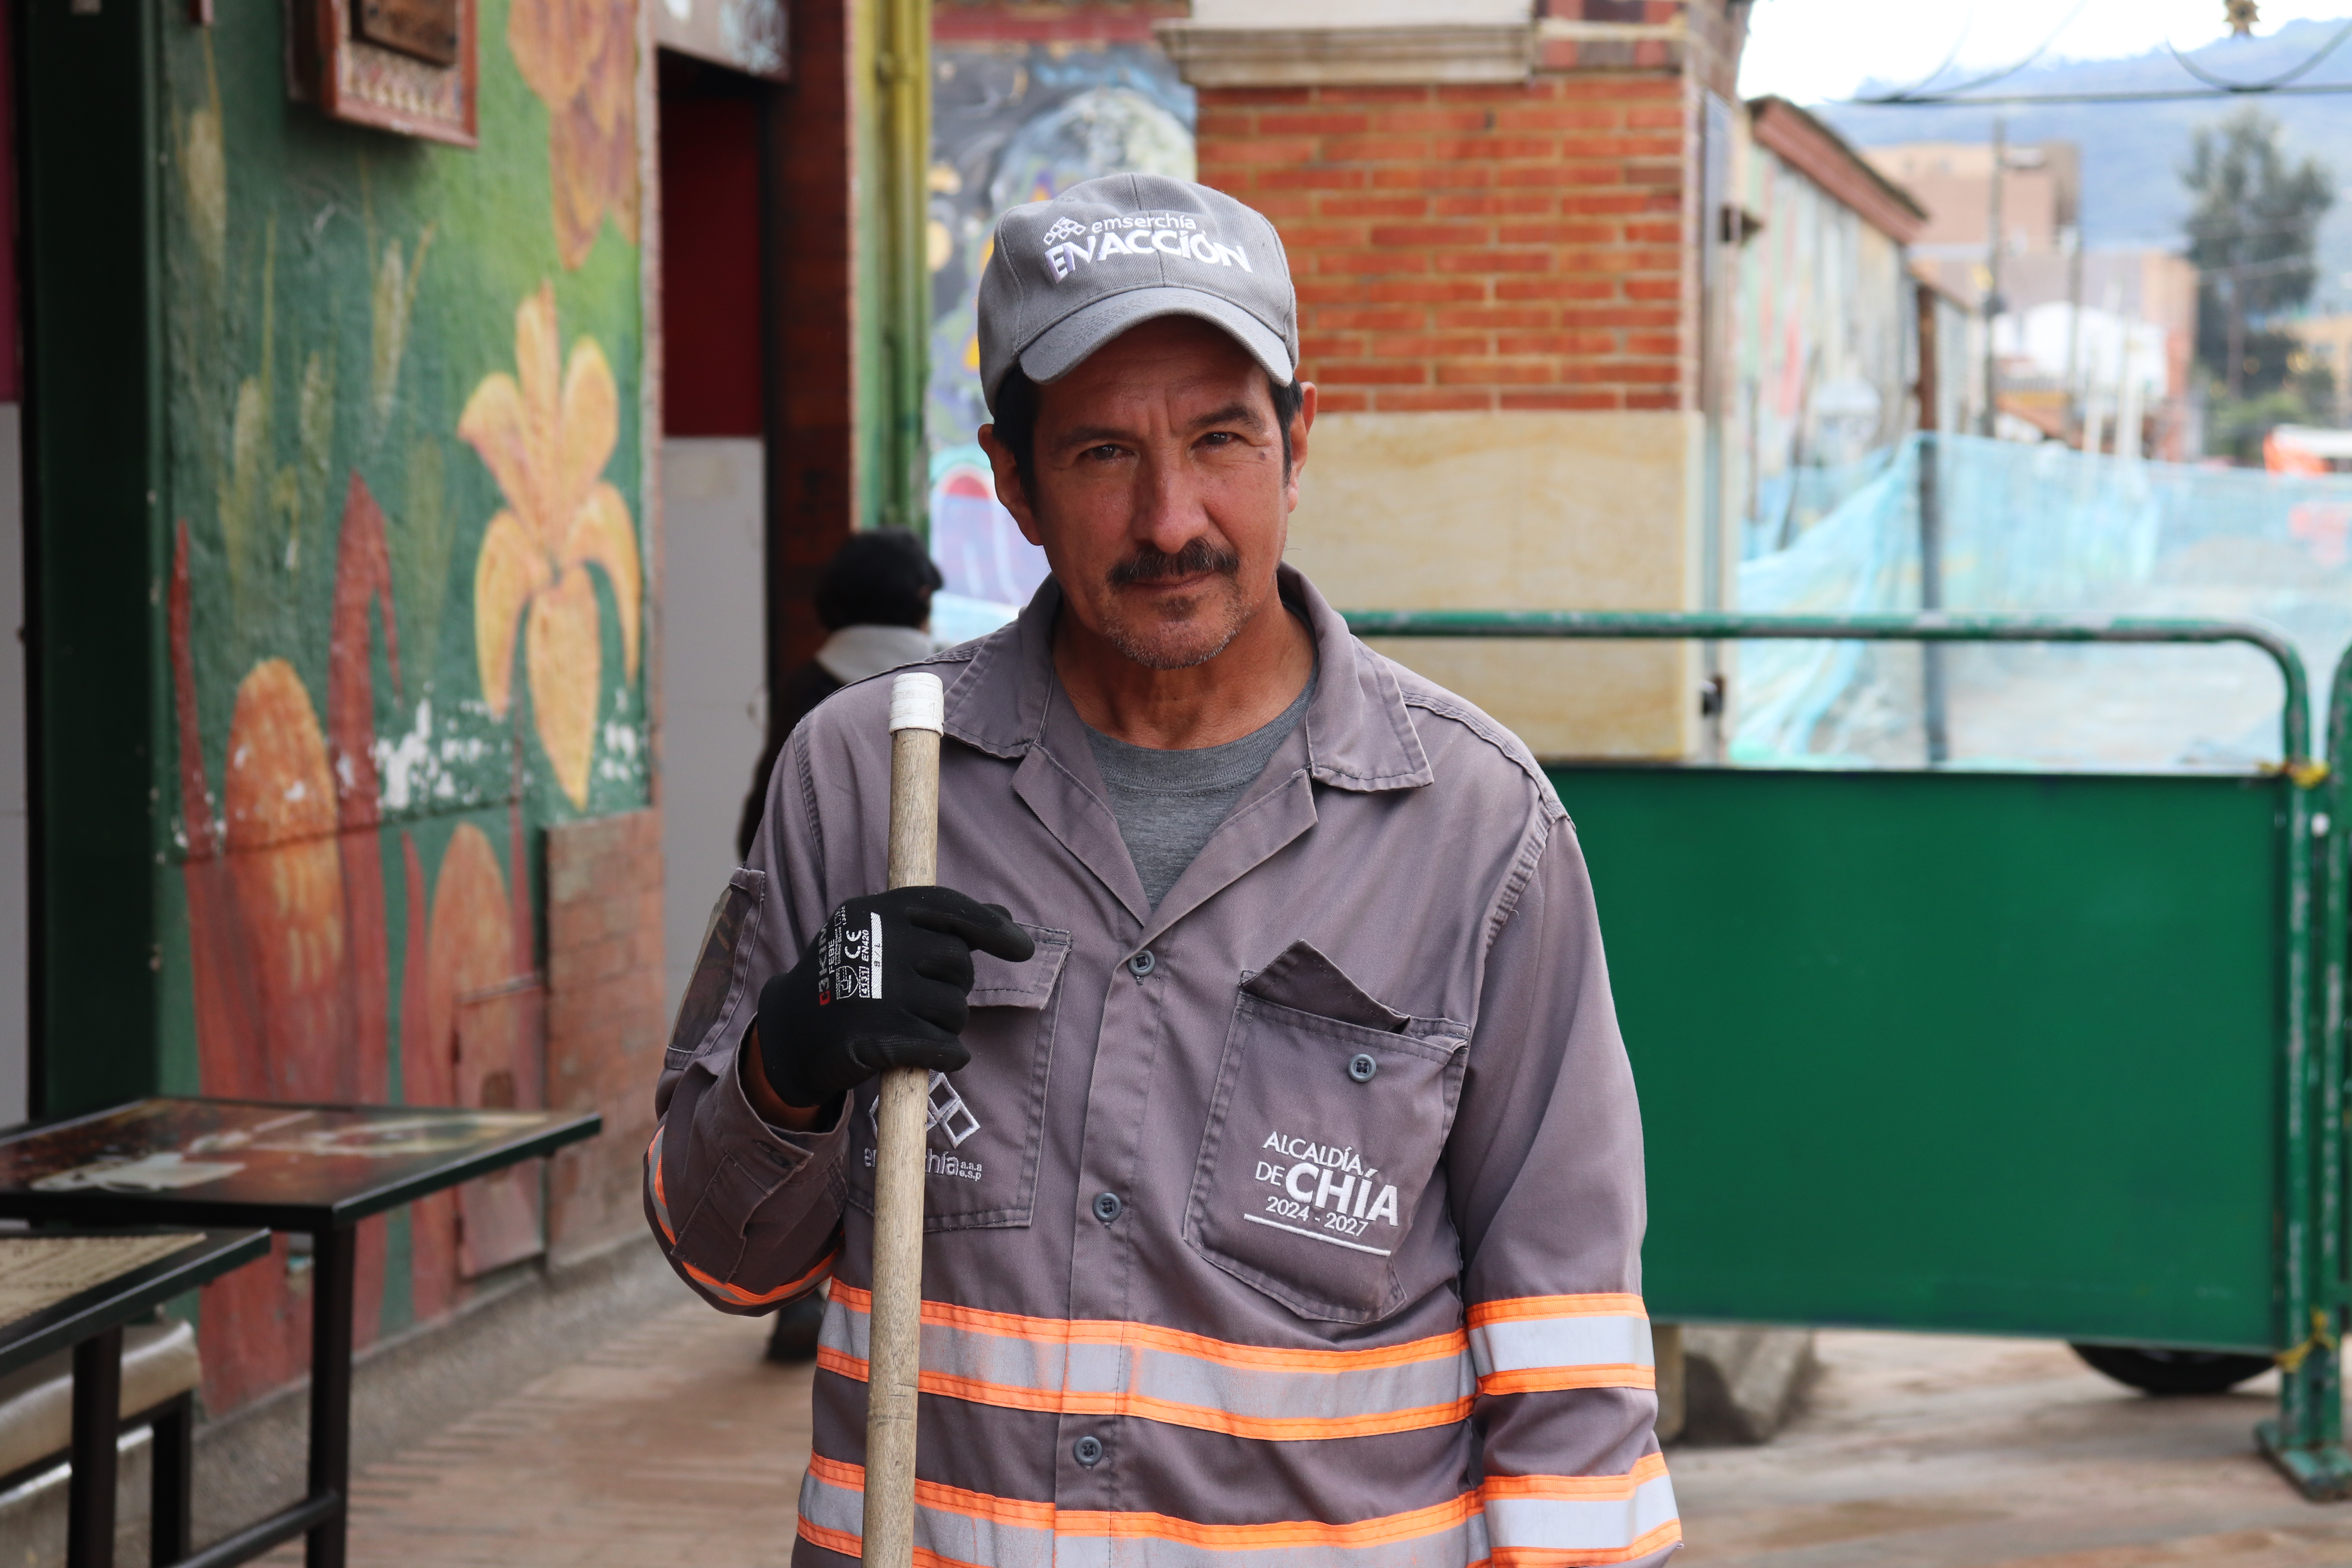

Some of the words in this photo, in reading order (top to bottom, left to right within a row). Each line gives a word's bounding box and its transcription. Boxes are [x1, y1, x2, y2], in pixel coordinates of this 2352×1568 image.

[1091, 213, 1196, 233] emserchía
[844, 930, 862, 959] CE
[861, 929, 869, 962] EN420
[1262, 1131, 1364, 1176] ALCALDÍA
[1255, 1161, 1285, 1186] DE
[1286, 1162, 1398, 1226] CHÍA
[1265, 1196, 1310, 1222] 2024
[1324, 1212, 1369, 1237] 2027
